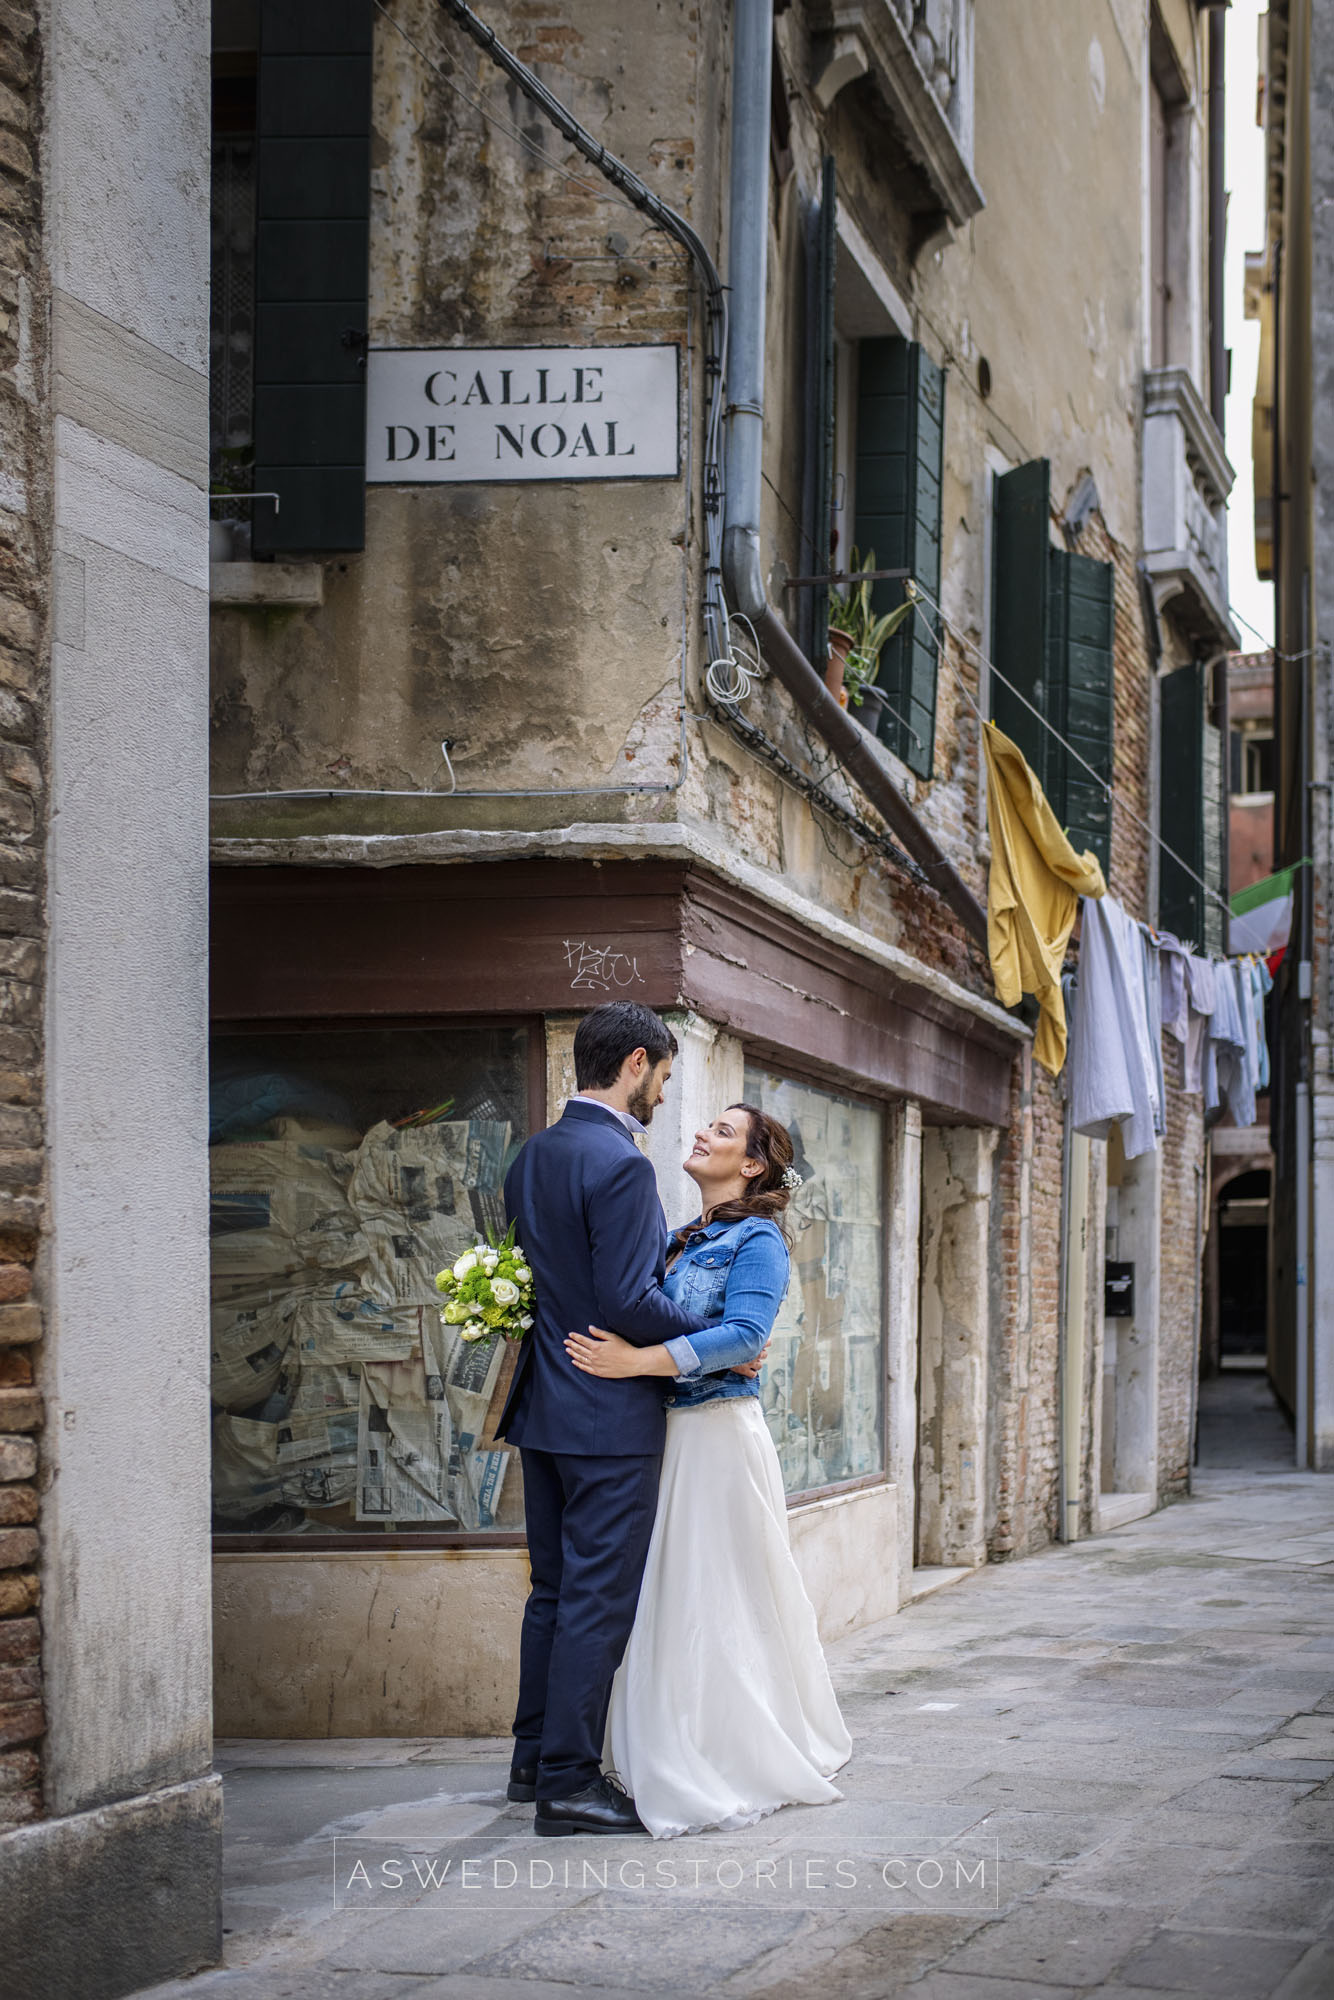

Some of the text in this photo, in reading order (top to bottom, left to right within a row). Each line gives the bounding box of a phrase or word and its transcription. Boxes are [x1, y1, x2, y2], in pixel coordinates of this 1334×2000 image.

[424, 367, 603, 405] CALLE
[385, 421, 635, 461] DE NOAL
